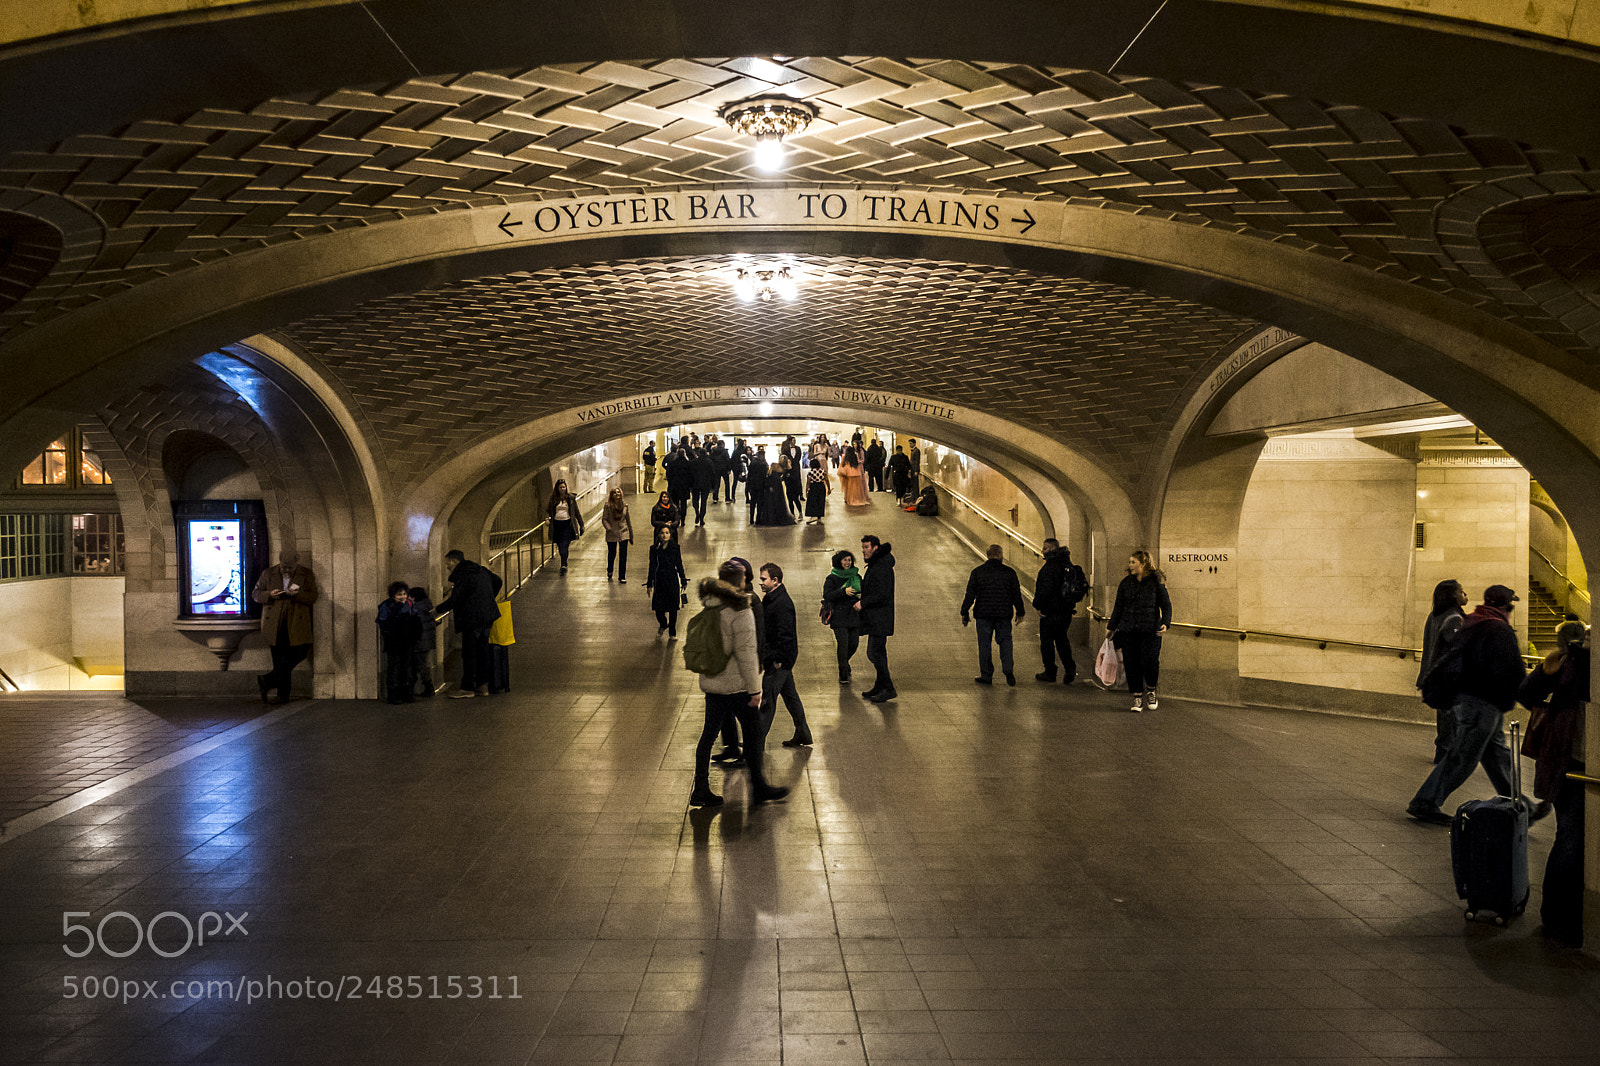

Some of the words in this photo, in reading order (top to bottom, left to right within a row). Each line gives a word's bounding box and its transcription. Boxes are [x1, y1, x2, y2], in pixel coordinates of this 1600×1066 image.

[534, 196, 675, 233] OYSTER
[688, 193, 760, 221] BAR
[798, 193, 847, 221] TO
[863, 194, 1000, 231] TRAINS
[577, 395, 662, 422] VANDERBILT
[666, 388, 721, 404] AVENUE
[733, 387, 769, 398] 42ND
[772, 387, 822, 399] STREET
[833, 390, 893, 406] SUBWAY
[894, 398, 955, 420] SHUTTLE
[1168, 553, 1228, 562] RESTROOMS
